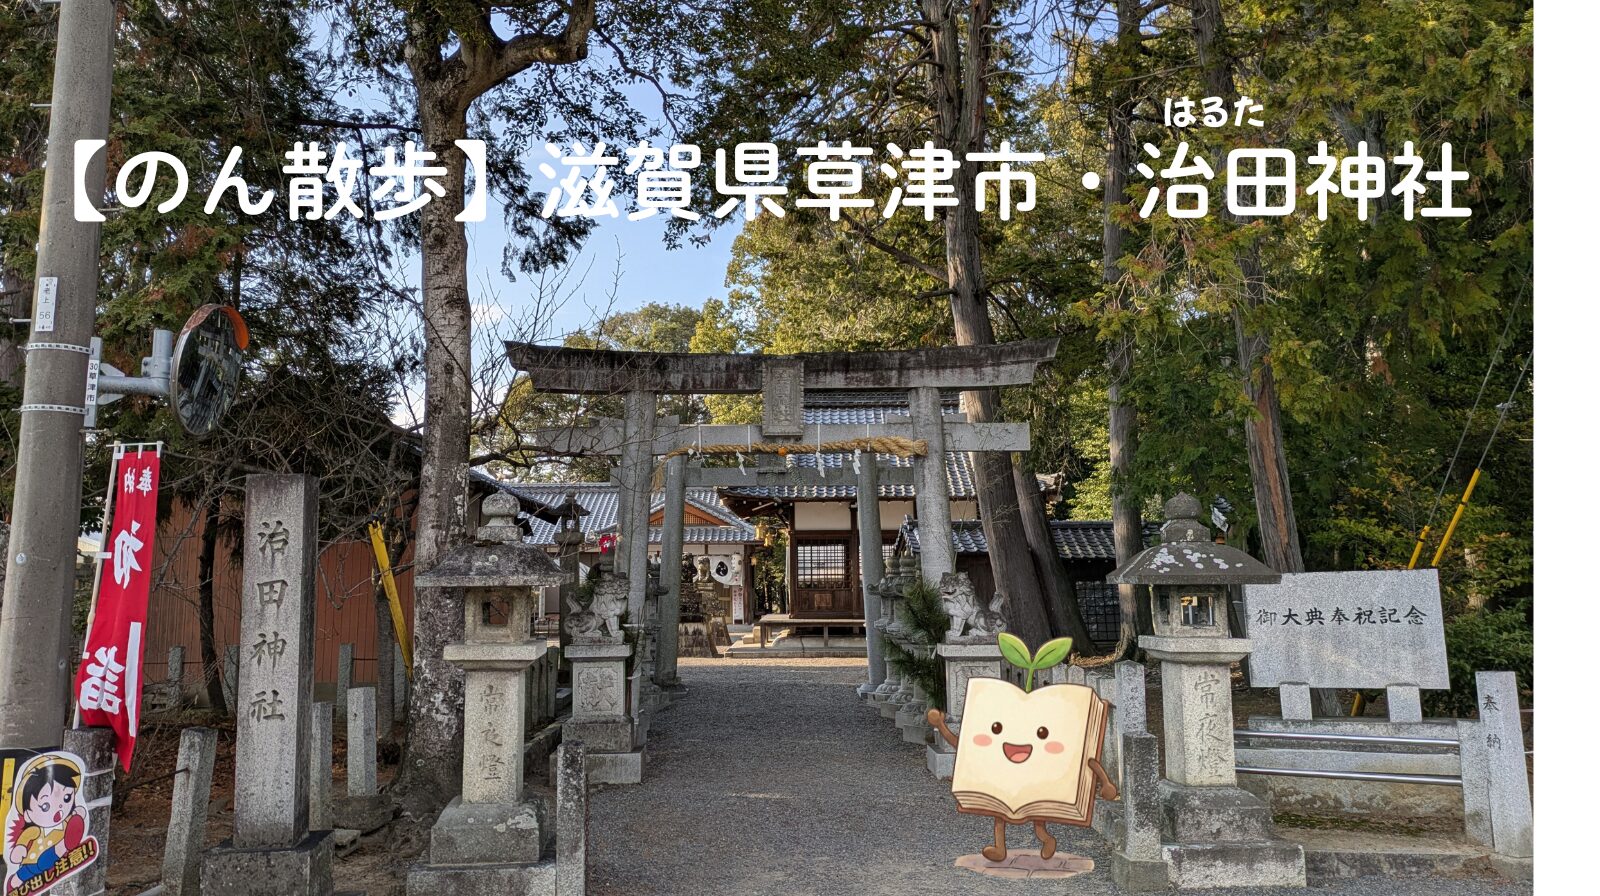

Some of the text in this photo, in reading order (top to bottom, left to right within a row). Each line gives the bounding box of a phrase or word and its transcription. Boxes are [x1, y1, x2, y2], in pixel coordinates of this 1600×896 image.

[39, 311, 51, 320] 56
[250, 520, 290, 725] 治田神社
[1255, 604, 1428, 626] 御大典奉祝記念
[1482, 694, 1502, 751] 奉納
